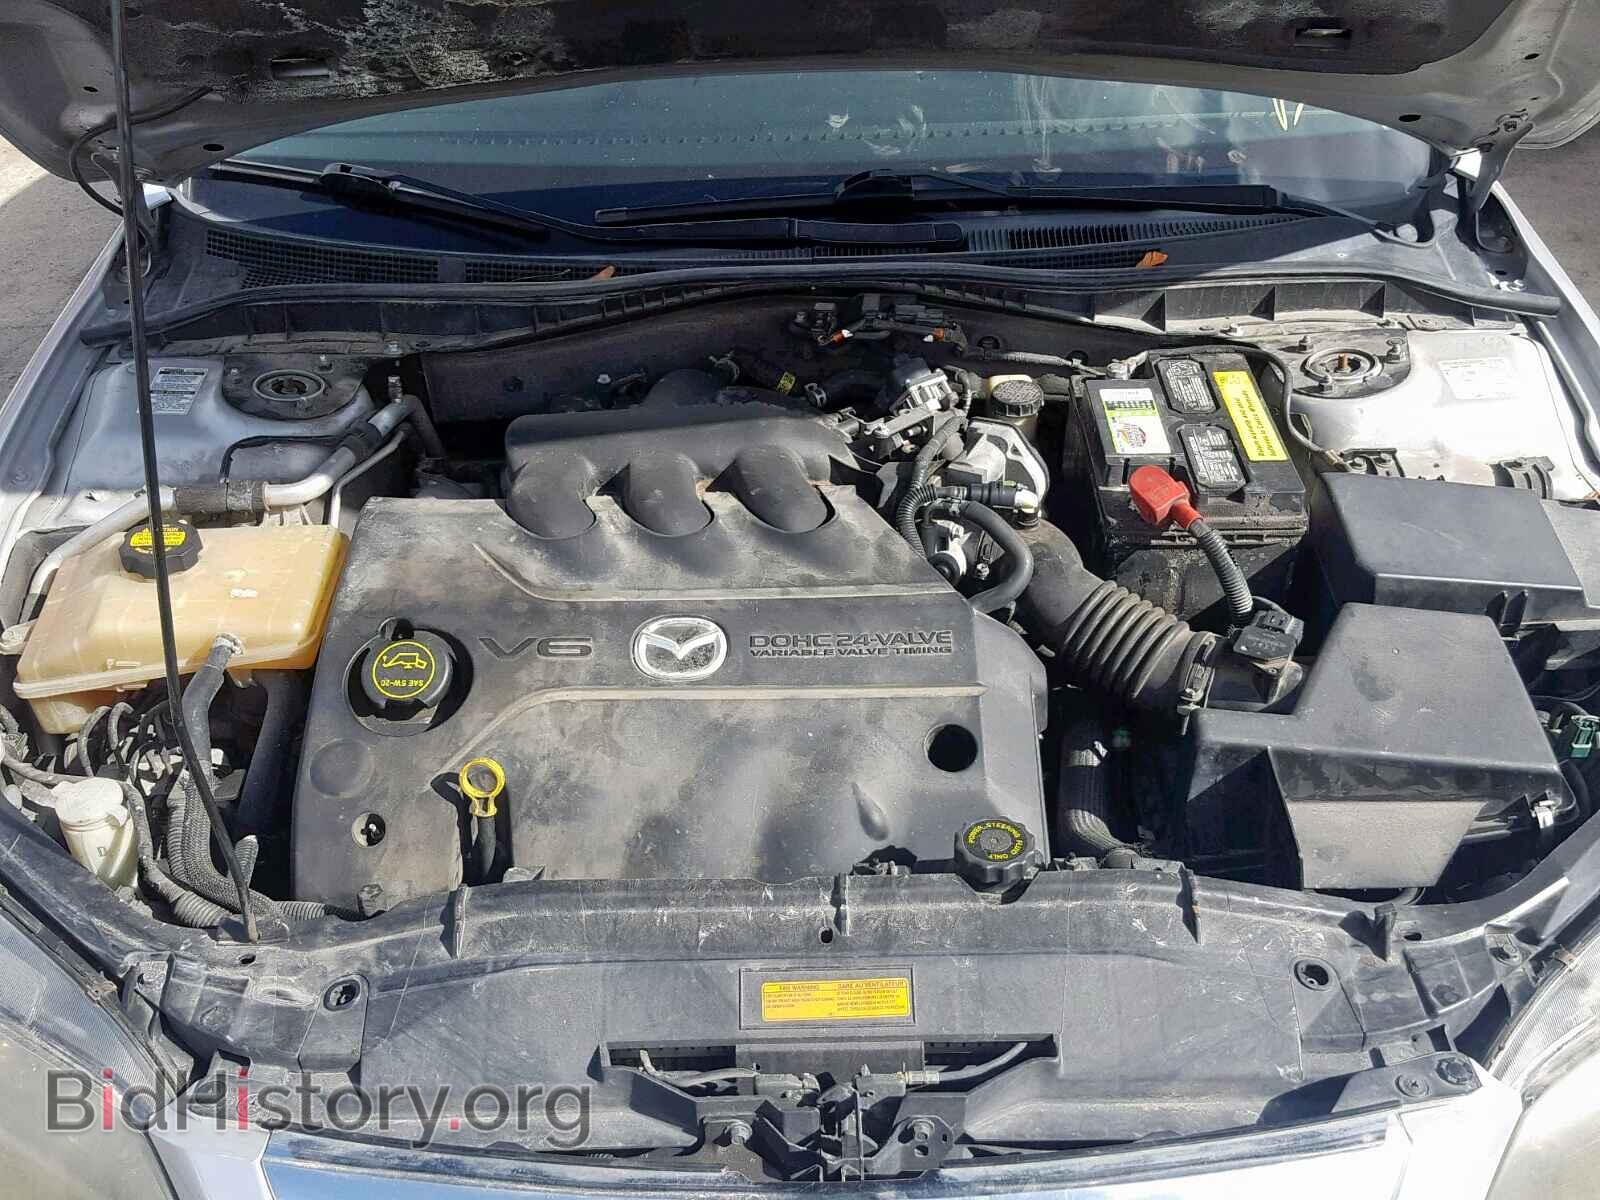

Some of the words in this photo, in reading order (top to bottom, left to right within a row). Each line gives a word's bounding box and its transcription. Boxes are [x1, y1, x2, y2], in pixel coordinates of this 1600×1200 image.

[750, 634, 833, 648] DOHC
[836, 631, 952, 647] 24-VALVE
[478, 636, 593, 659] V6
[750, 648, 834, 657] VARIABLE
[836, 648, 889, 656] VALVE
[893, 647, 952, 655] TIMING
[380, 679, 407, 687] 5W-20
[408, 679, 424, 687] SAE
